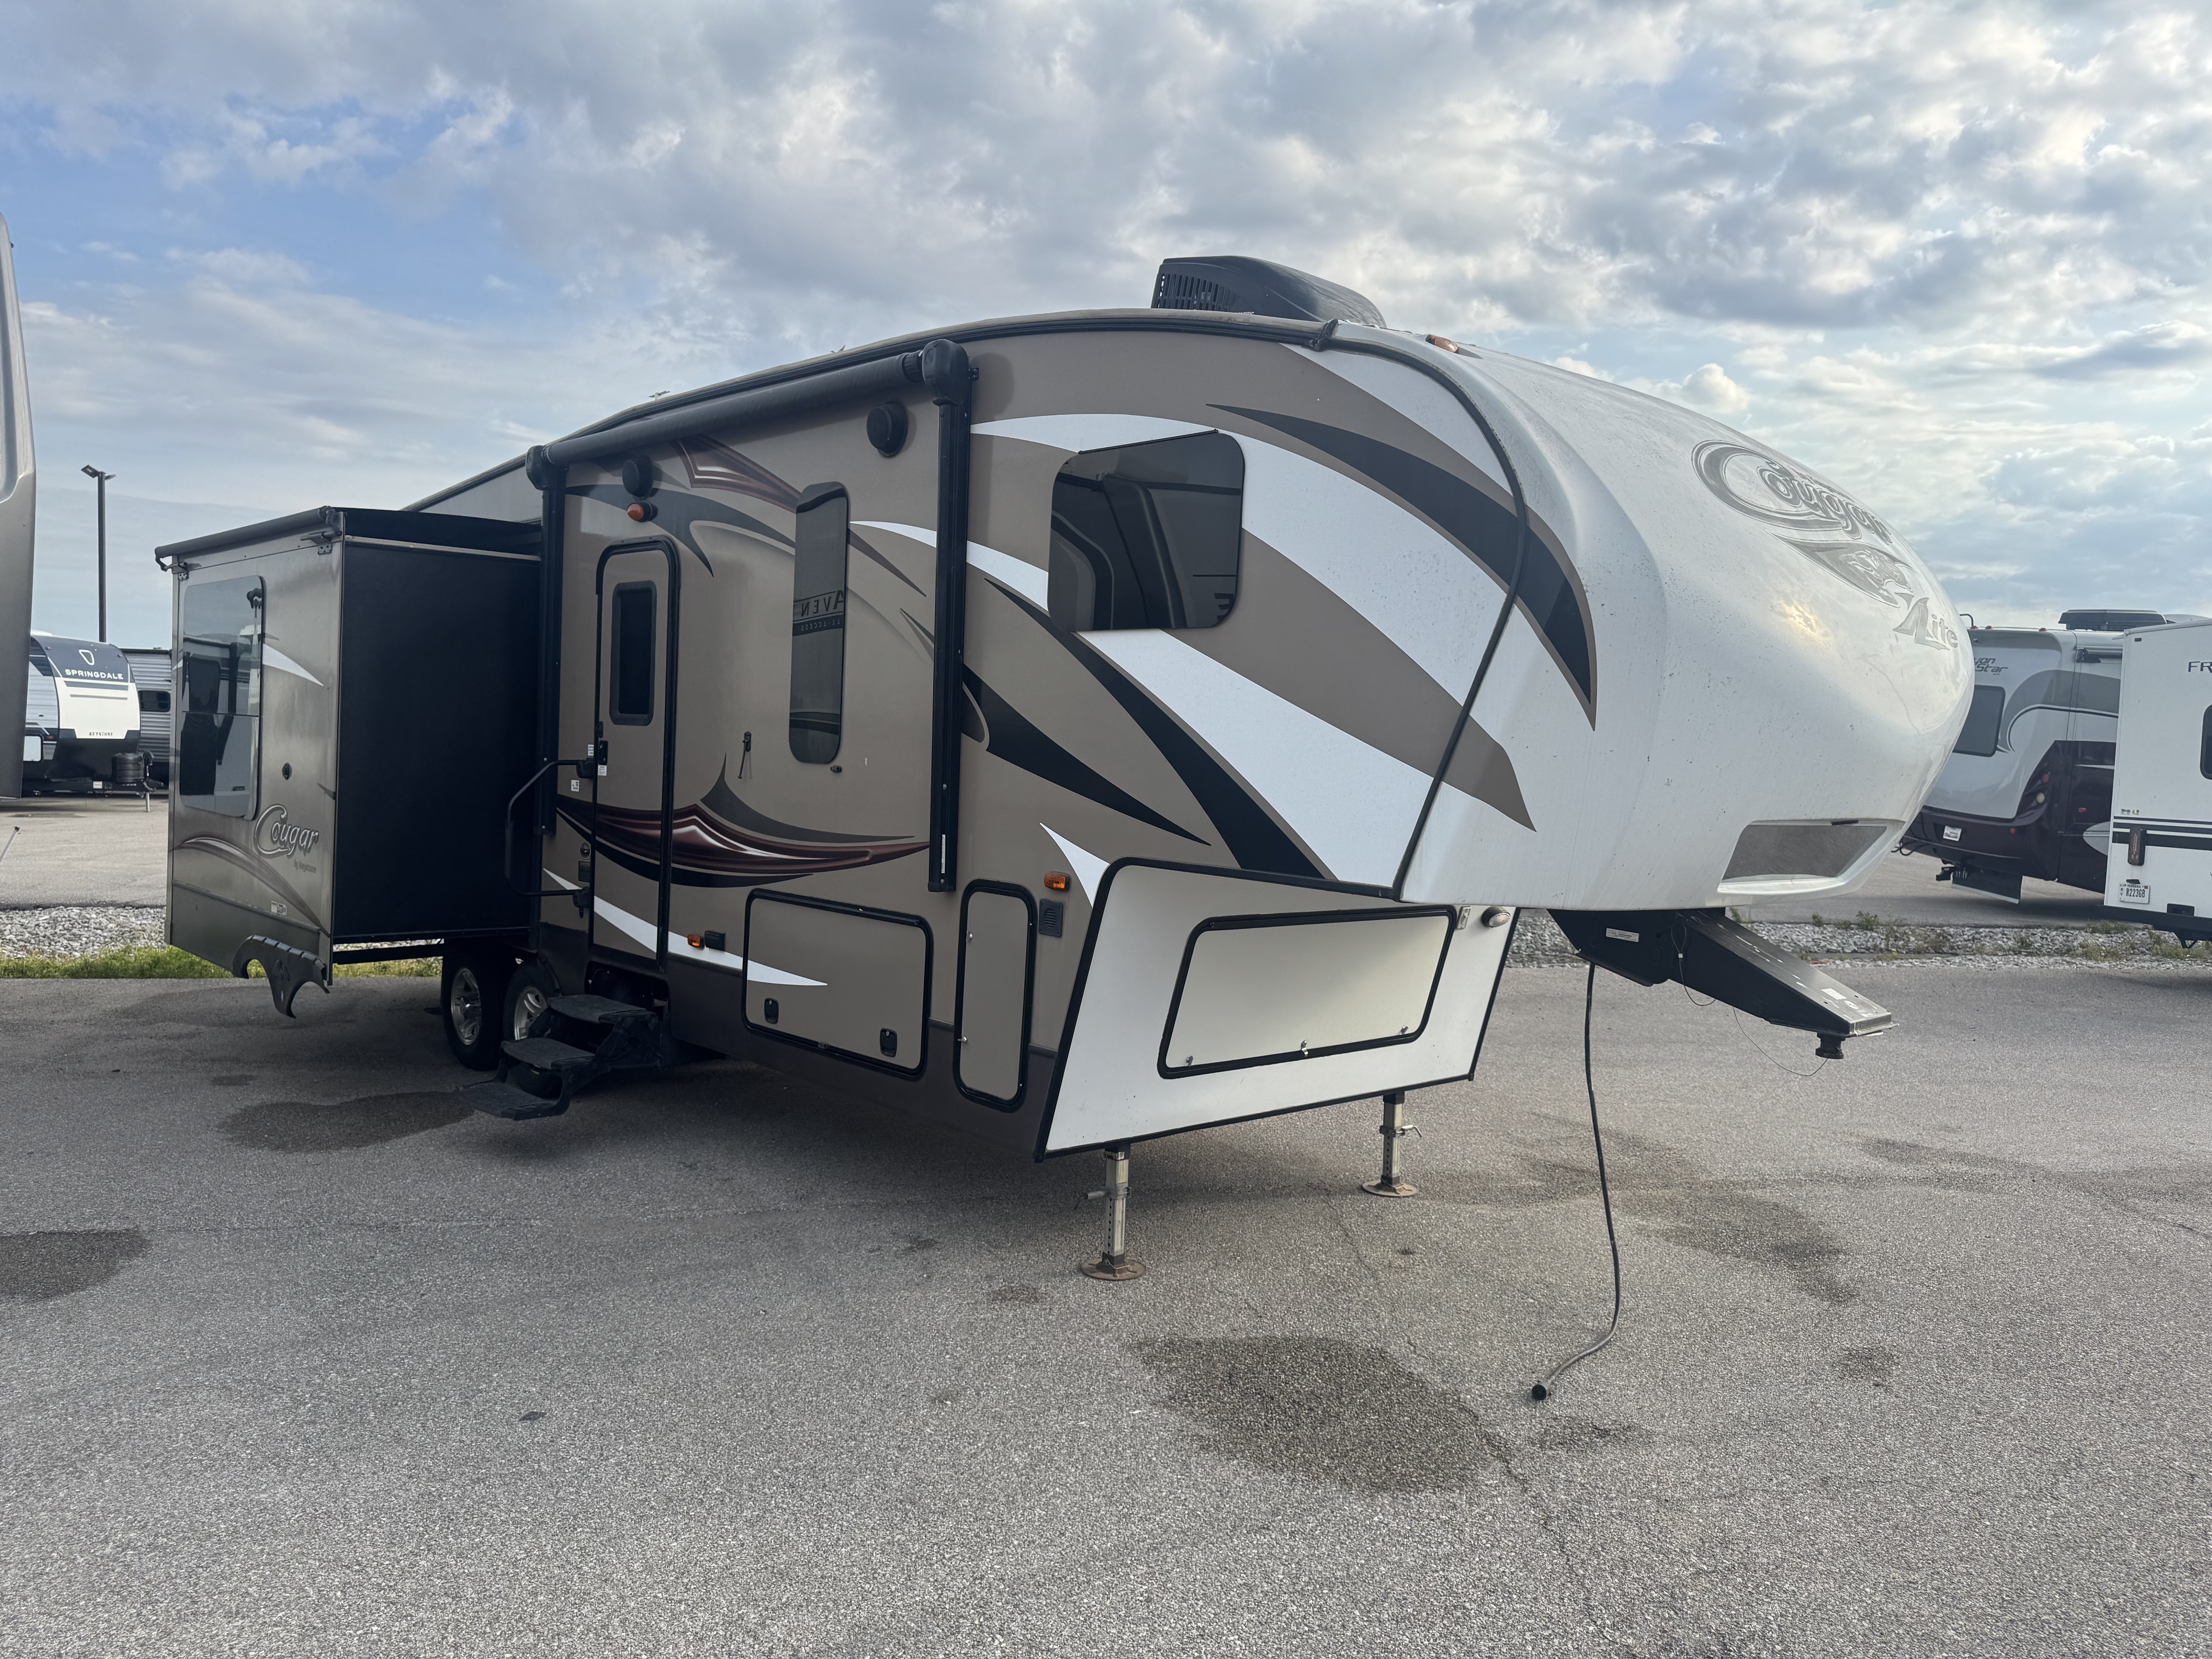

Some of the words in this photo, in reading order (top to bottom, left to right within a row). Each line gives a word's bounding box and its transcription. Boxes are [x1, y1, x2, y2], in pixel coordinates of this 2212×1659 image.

[1691, 440, 1893, 545] Cougar
[1975, 664, 2008, 673] Star
[2188, 661, 2212, 673] FR
[65, 669, 124, 680] SPRINGDALE
[253, 804, 319, 859] Cougar
[2126, 888, 2145, 897] R223GB
